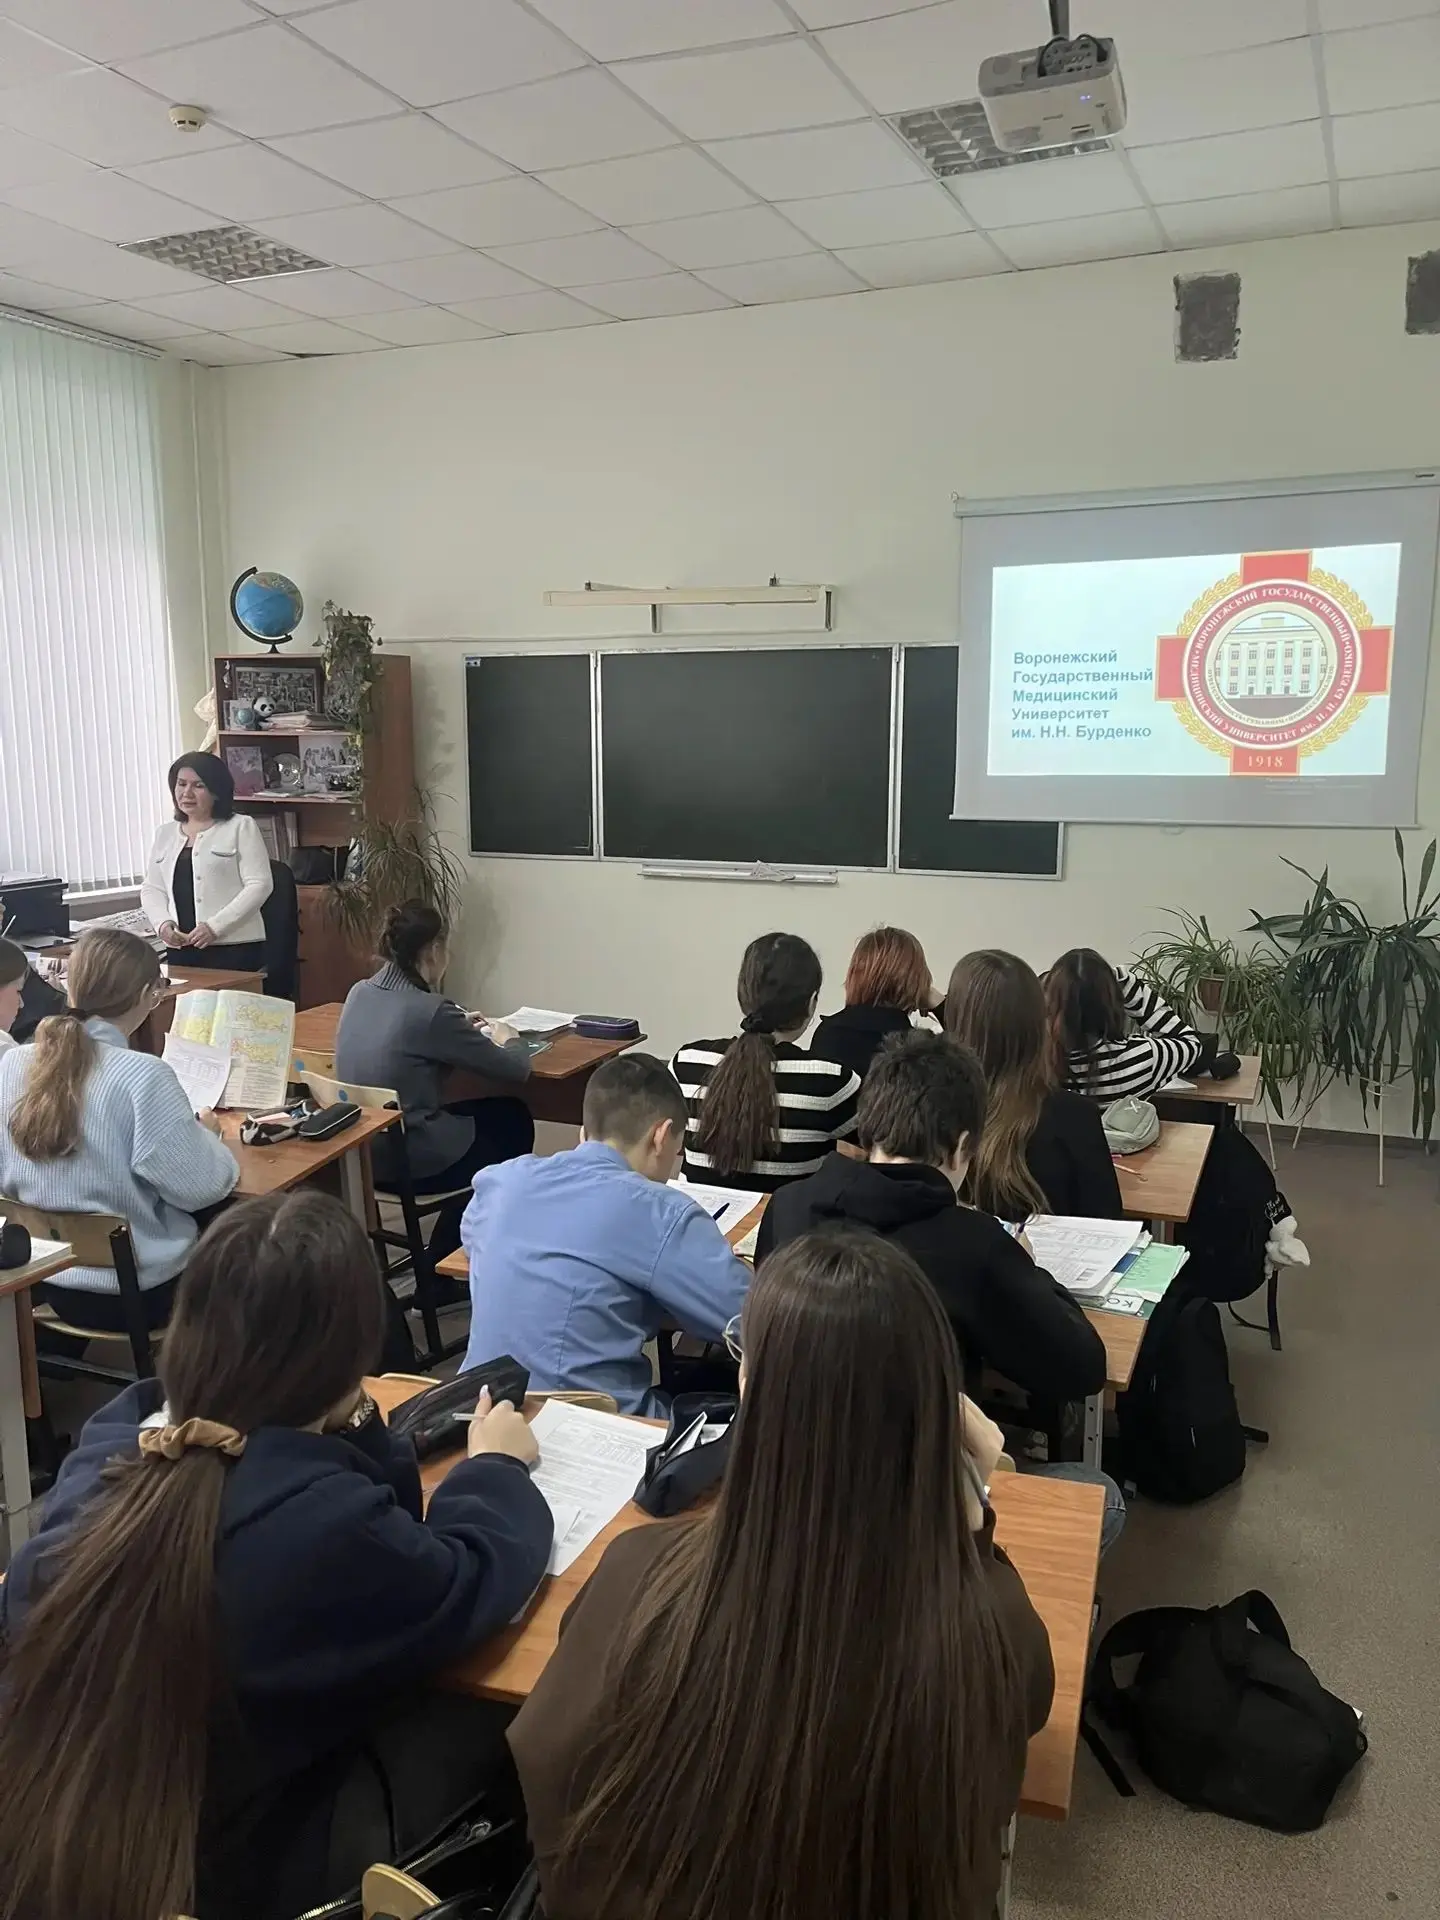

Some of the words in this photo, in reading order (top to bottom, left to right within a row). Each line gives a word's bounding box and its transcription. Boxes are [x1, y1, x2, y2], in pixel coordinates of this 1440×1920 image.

[1195, 589, 1258, 649] ВОРОНЕЖСКИЙ
[1262, 587, 1350, 642] ГОСУДАРСТВЕННЫЙ
[1013, 650, 1118, 667] Воронежский
[1013, 668, 1153, 686] Государственный
[1013, 688, 1118, 704] Медицинский
[1011, 708, 1110, 722] Университет
[1011, 728, 1036, 739] им.
[1040, 725, 1071, 739] Н.Н.
[1076, 725, 1152, 740] Бурденко
[1222, 722, 1298, 743] УНИВЕРСИТЕТ
[1248, 755, 1283, 768] 1918
